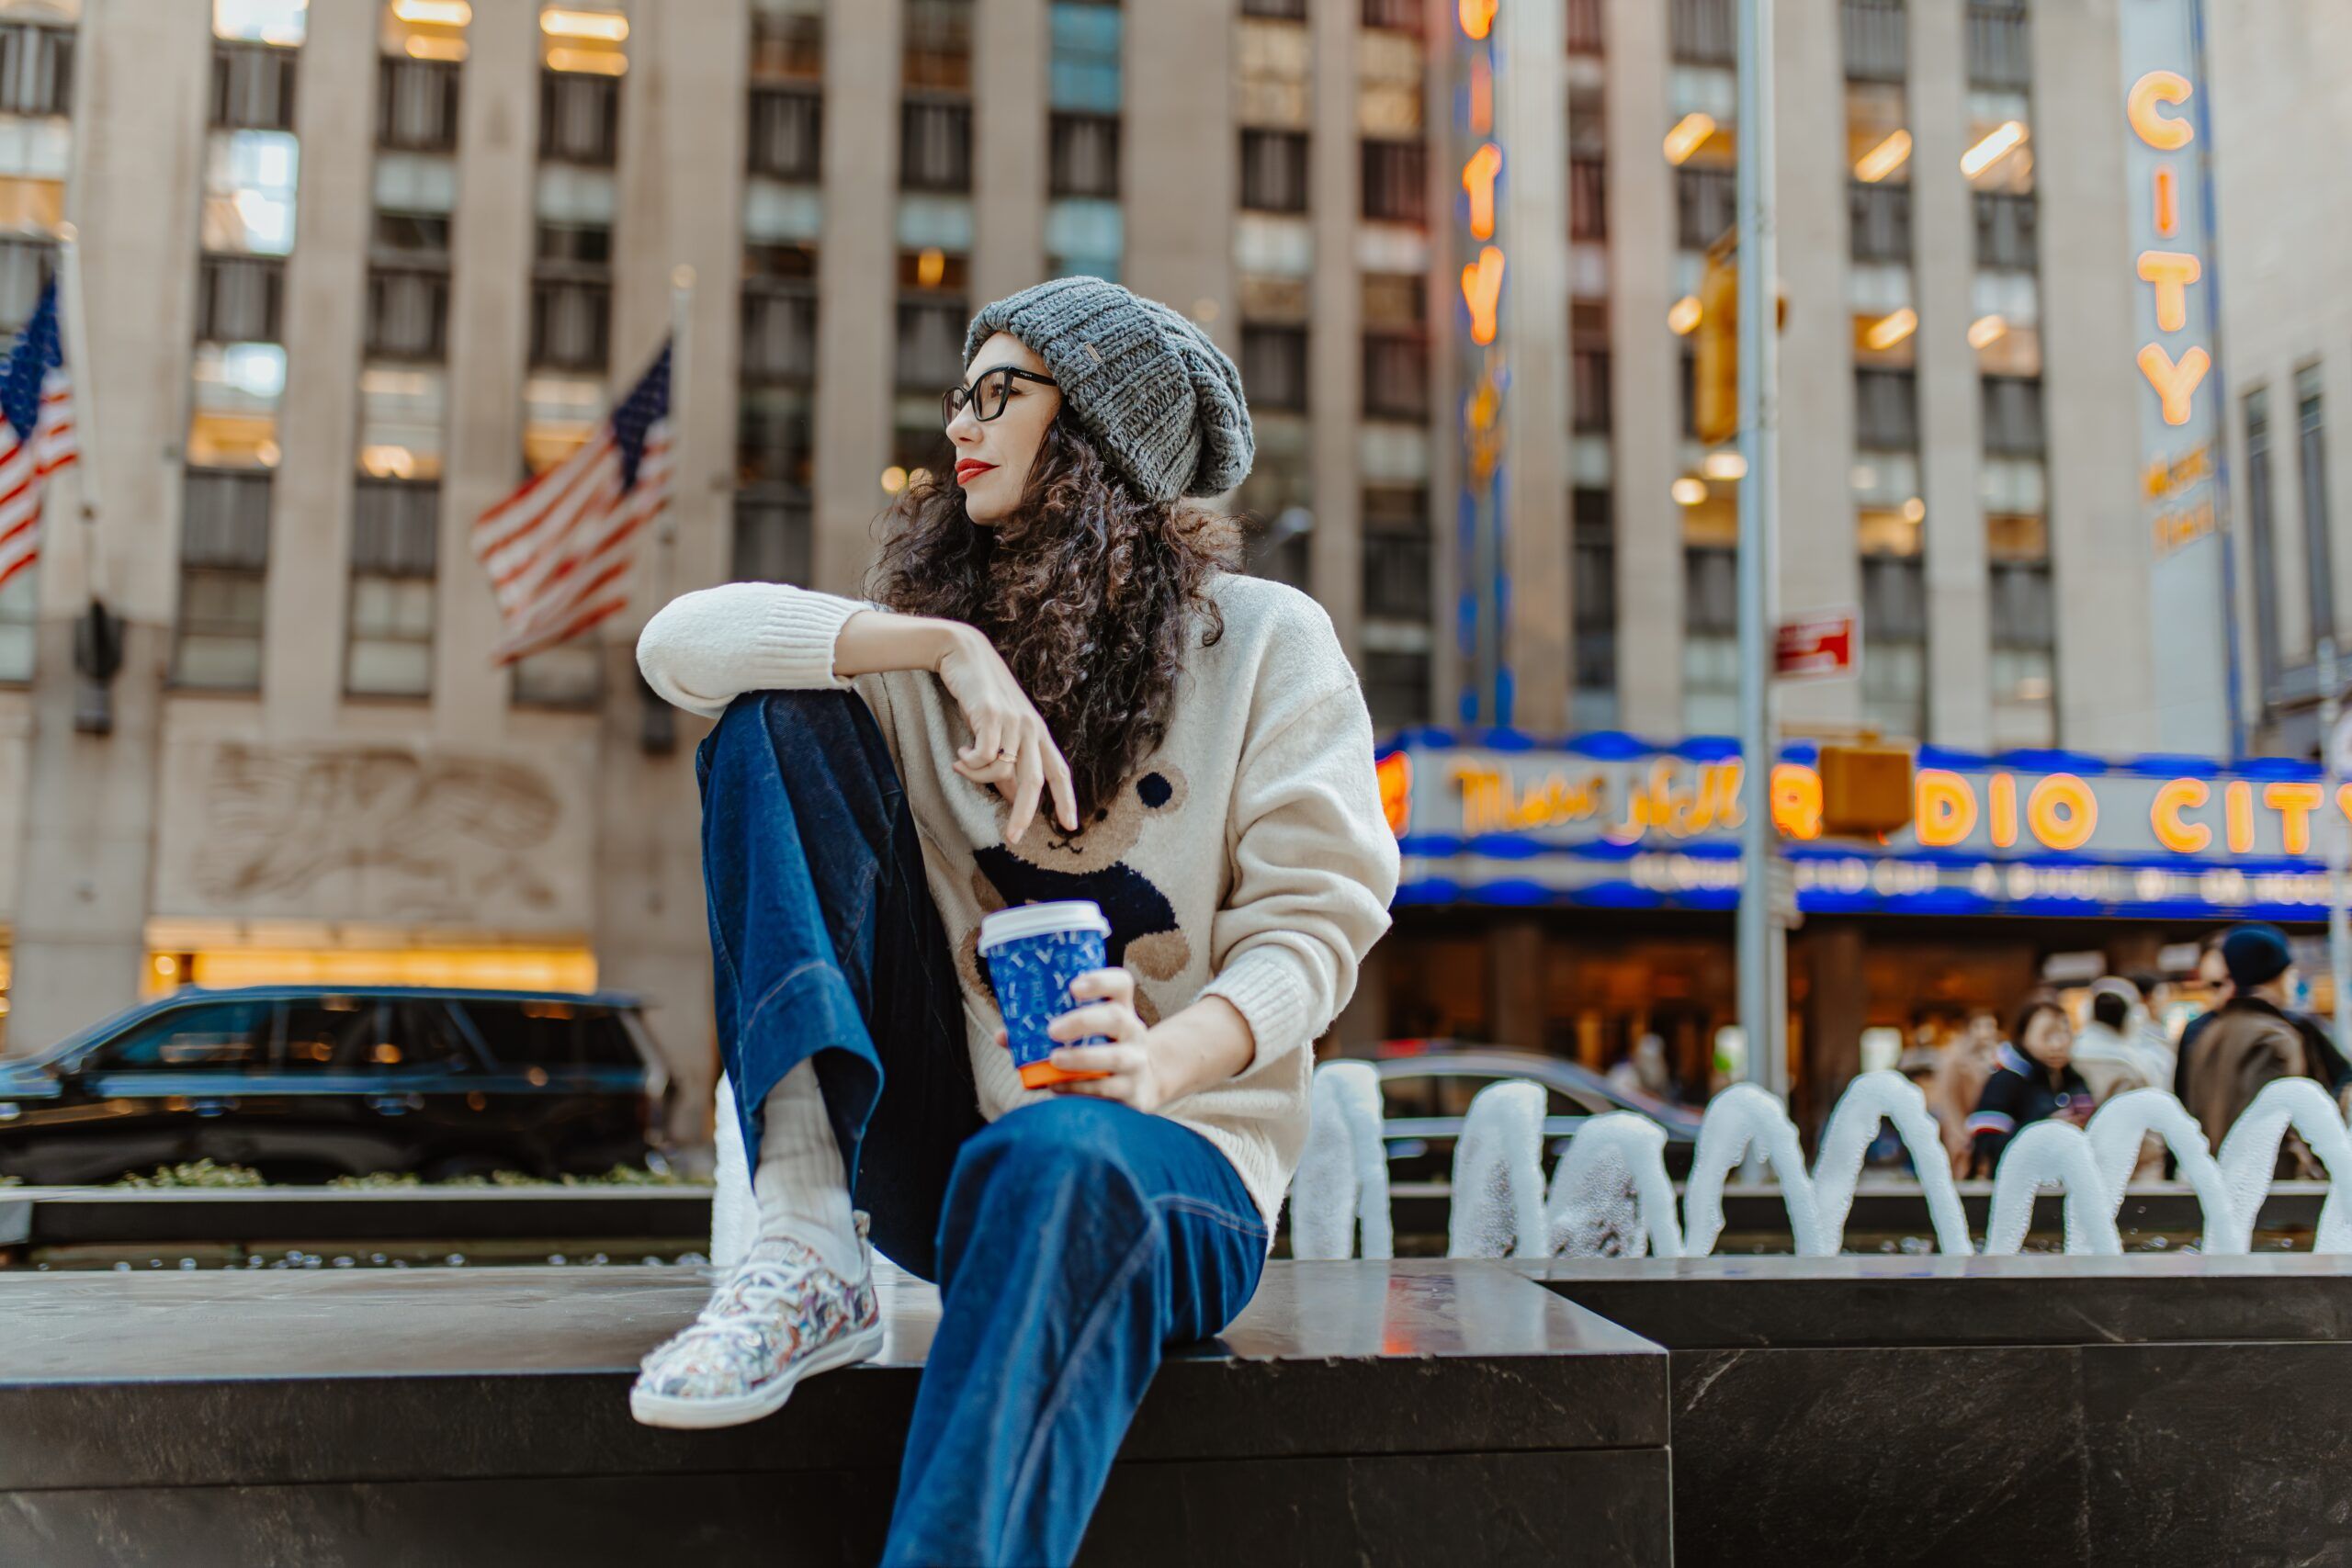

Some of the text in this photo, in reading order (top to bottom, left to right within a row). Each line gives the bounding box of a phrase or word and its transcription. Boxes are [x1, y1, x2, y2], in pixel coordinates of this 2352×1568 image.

[2127, 69, 2211, 426] CITY
[1770, 764, 2352, 854] RDIO CIT
